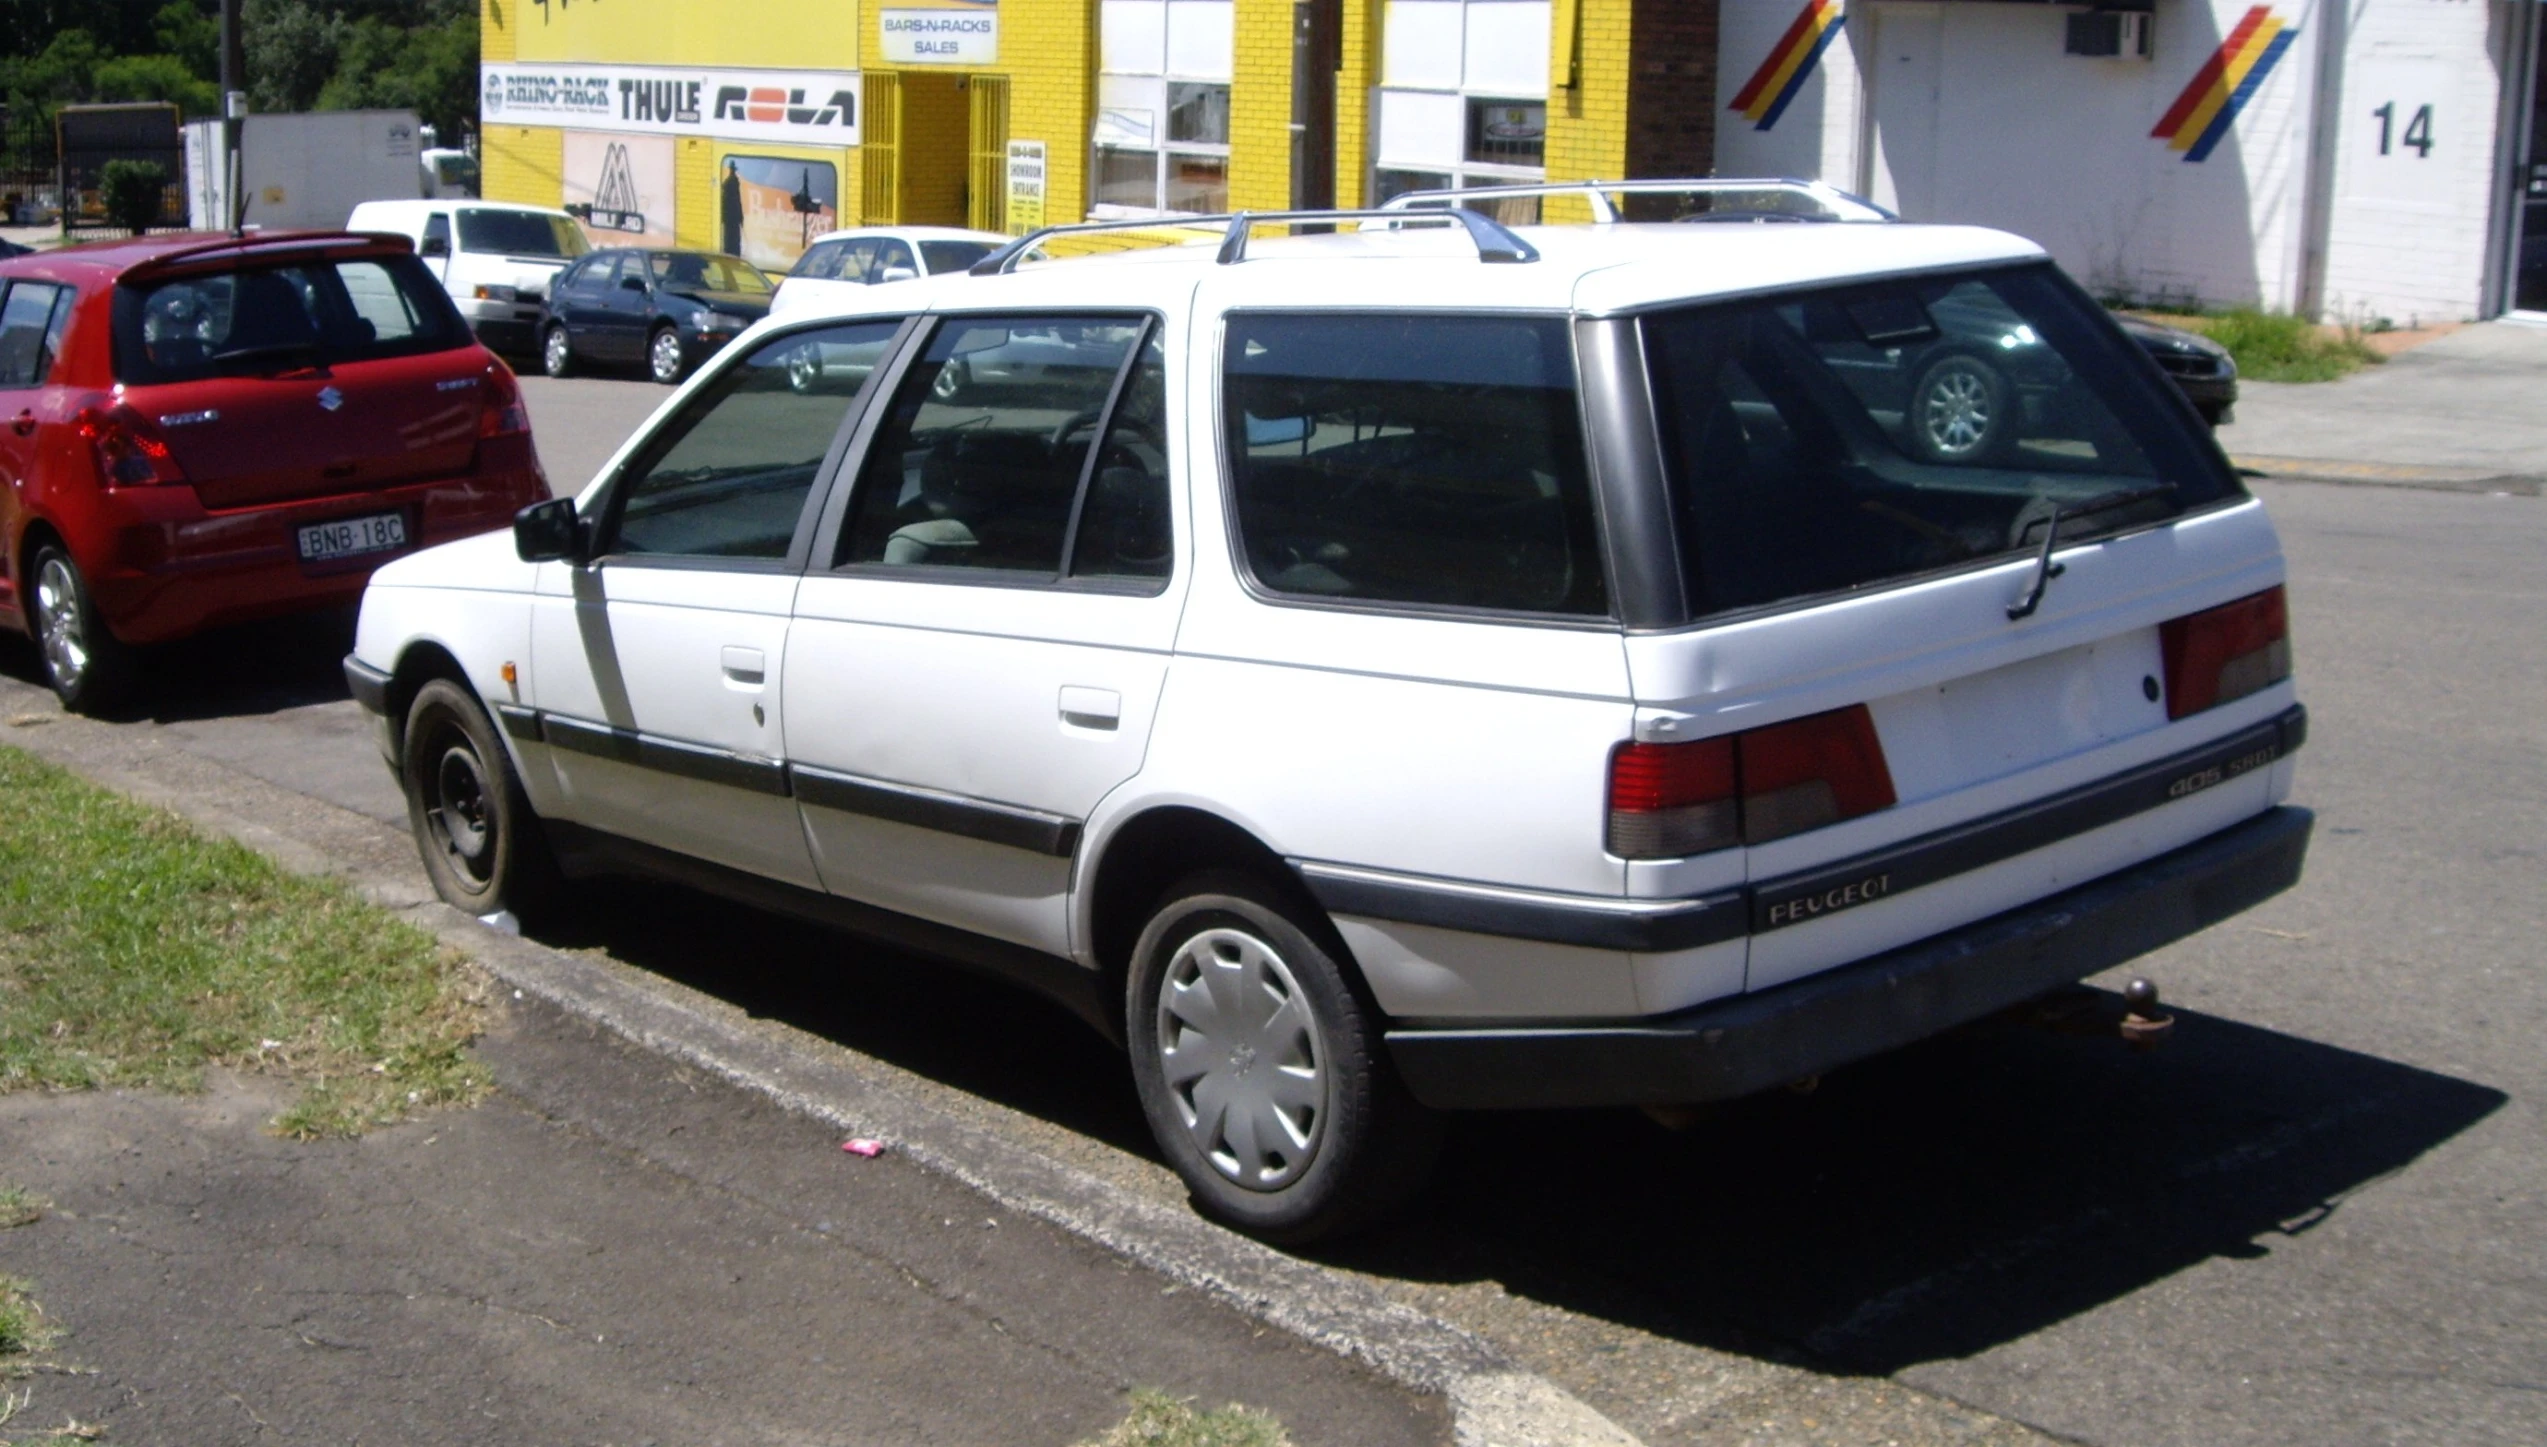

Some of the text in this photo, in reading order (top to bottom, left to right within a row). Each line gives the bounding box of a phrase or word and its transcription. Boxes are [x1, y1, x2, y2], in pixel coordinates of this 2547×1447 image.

[885, 19, 991, 33] BARS-N-RACKS
[914, 41, 959, 54] SALES
[506, 76, 609, 106] RHINO-RACK
[618, 79, 701, 123] THULE
[714, 85, 855, 127] ROLA
[2372, 100, 2434, 158] 14
[1769, 874, 1890, 924] PEUGEOT
